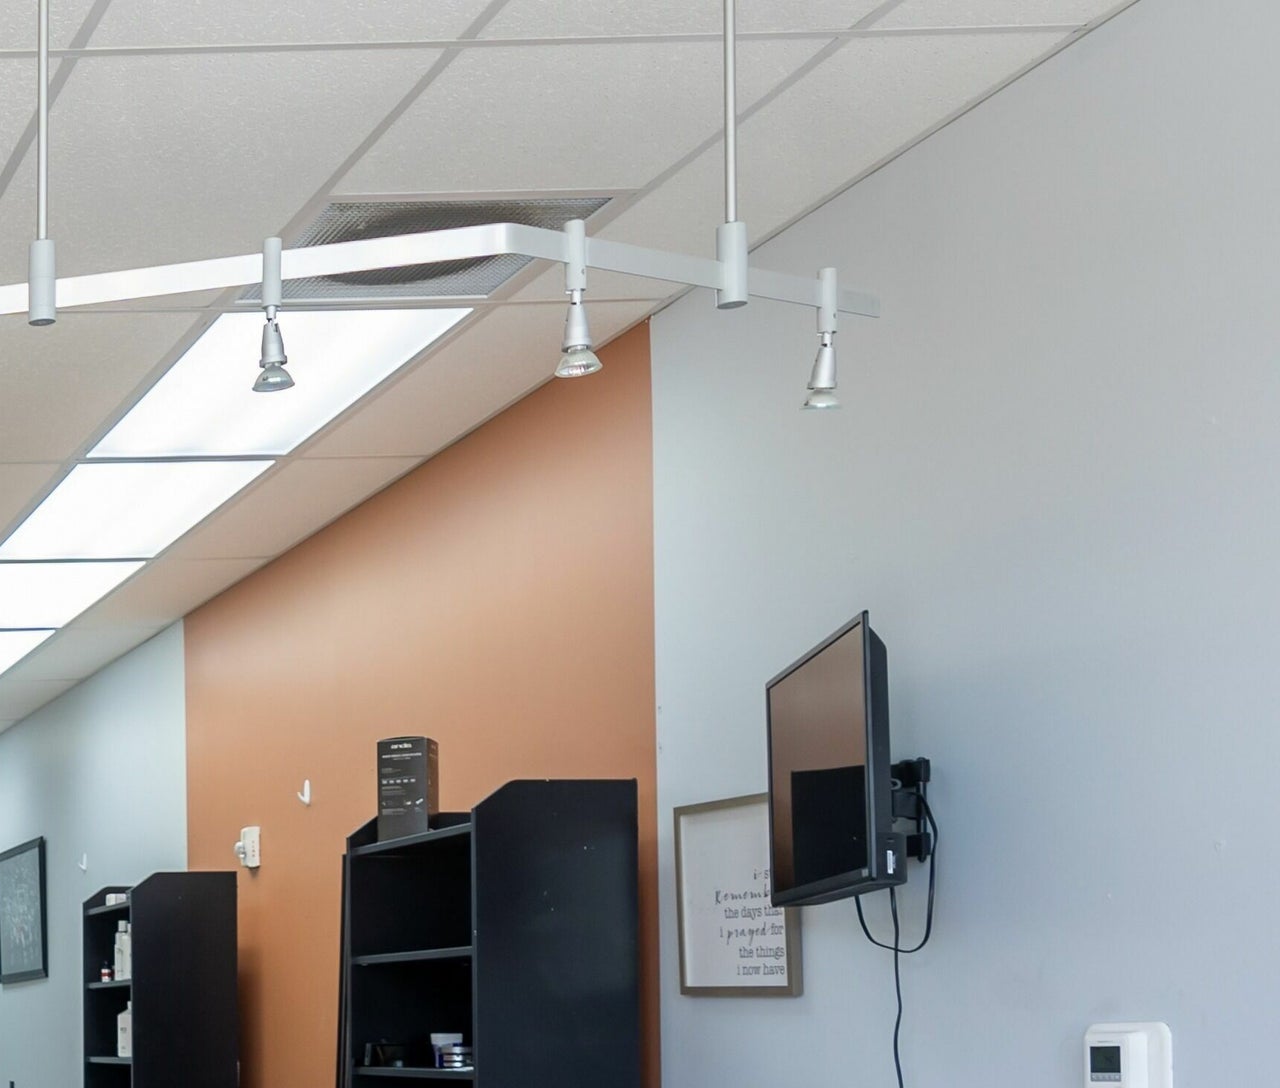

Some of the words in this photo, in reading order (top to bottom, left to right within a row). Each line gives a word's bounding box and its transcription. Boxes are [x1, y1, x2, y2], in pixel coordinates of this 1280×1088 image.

[724, 906, 739, 919] the
[741, 906, 762, 920] days
[770, 923, 784, 936] for
[739, 946, 753, 958] the
[755, 946, 785, 960] things
[742, 966, 761, 975] now
[763, 963, 785, 975] have
